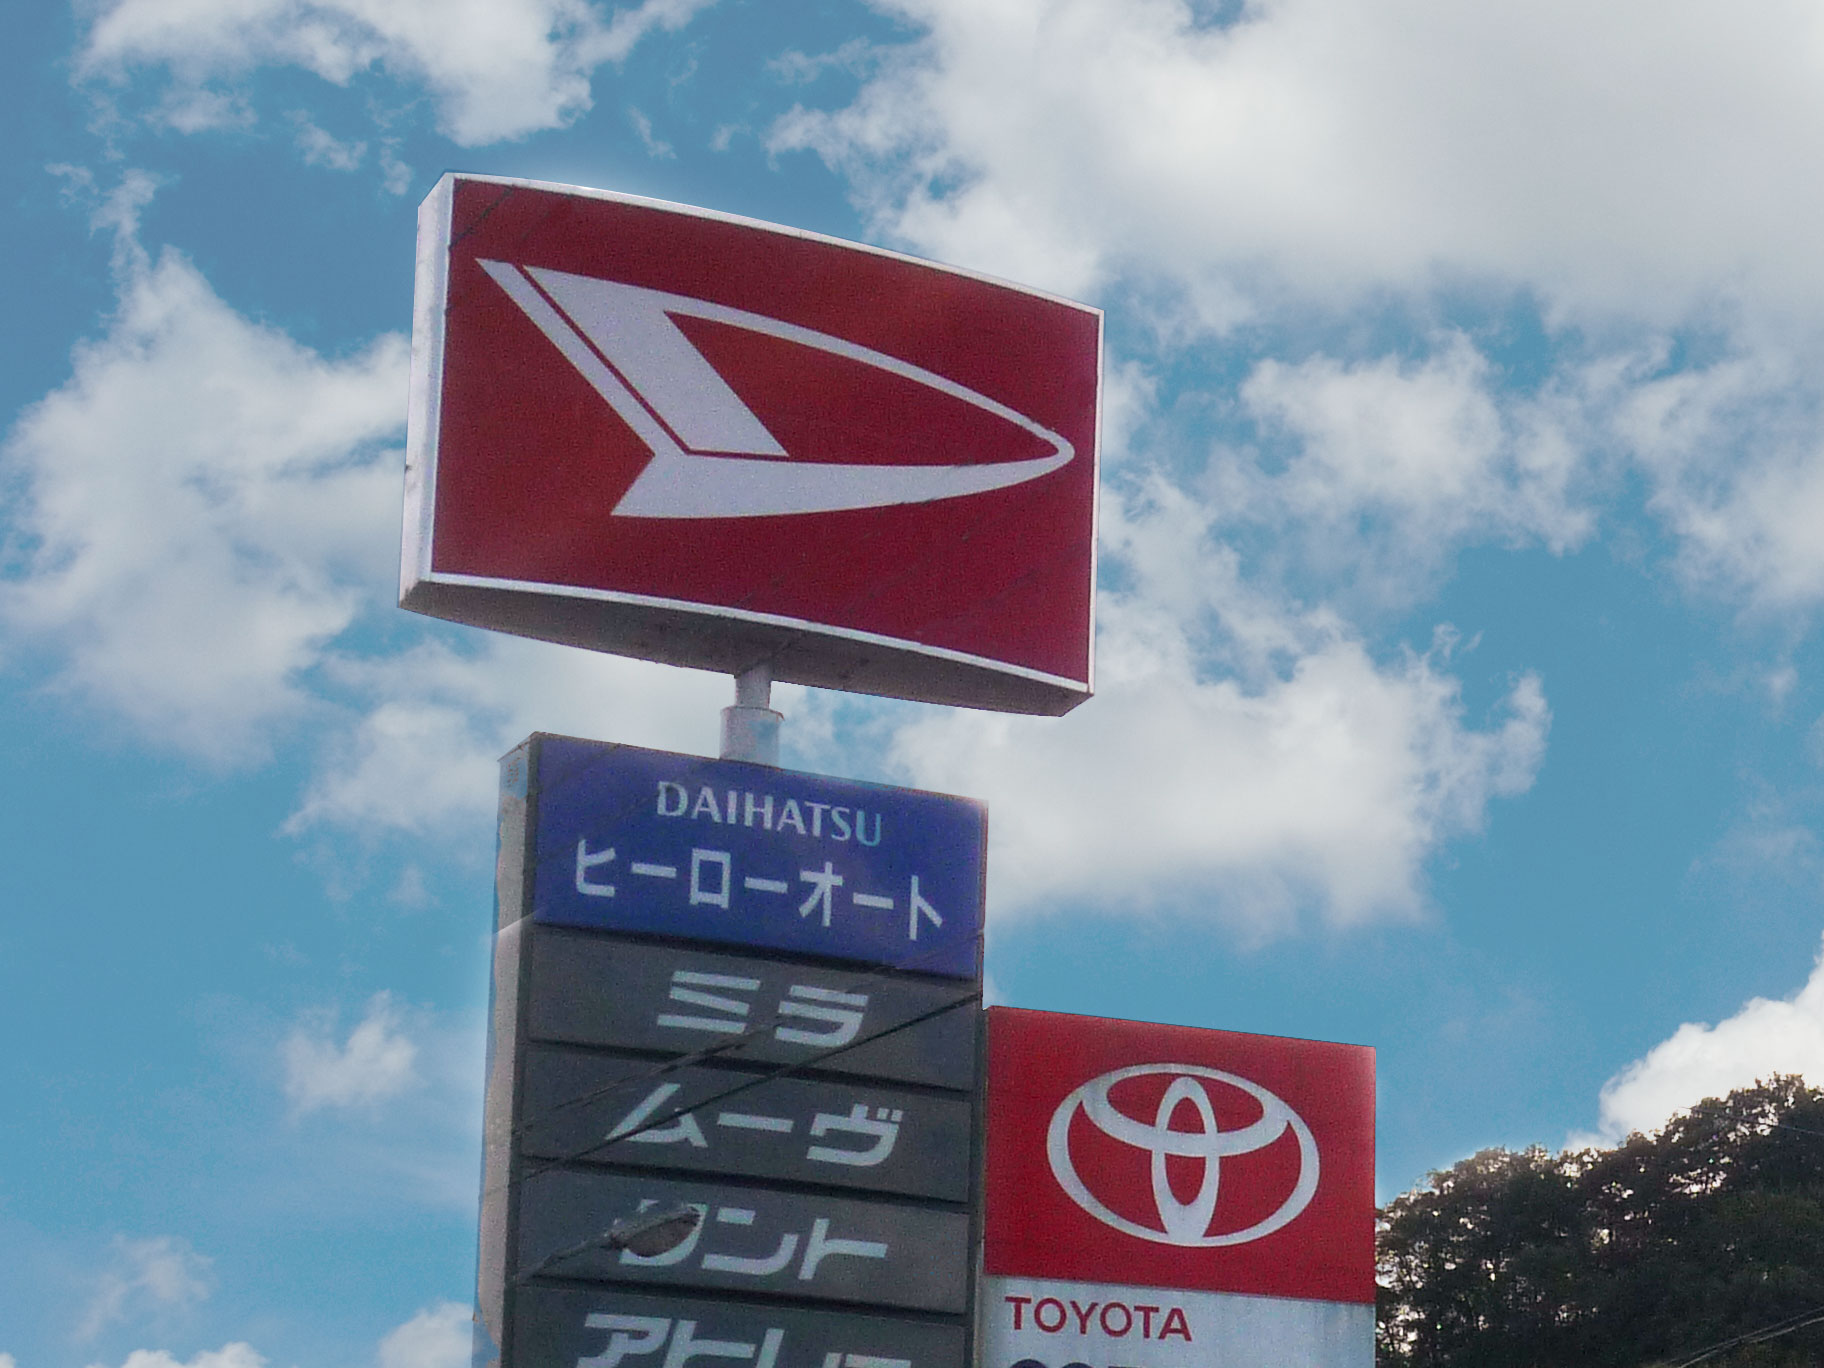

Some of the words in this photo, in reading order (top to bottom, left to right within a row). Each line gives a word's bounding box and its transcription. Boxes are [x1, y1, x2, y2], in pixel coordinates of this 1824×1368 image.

[656, 781, 882, 847] DAIHATSU
[575, 838, 943, 941] ヒーローオート
[657, 970, 868, 1048] ミラ
[605, 1083, 902, 1167] ムーヴ
[1005, 1295, 1192, 1342] TOYOTA
